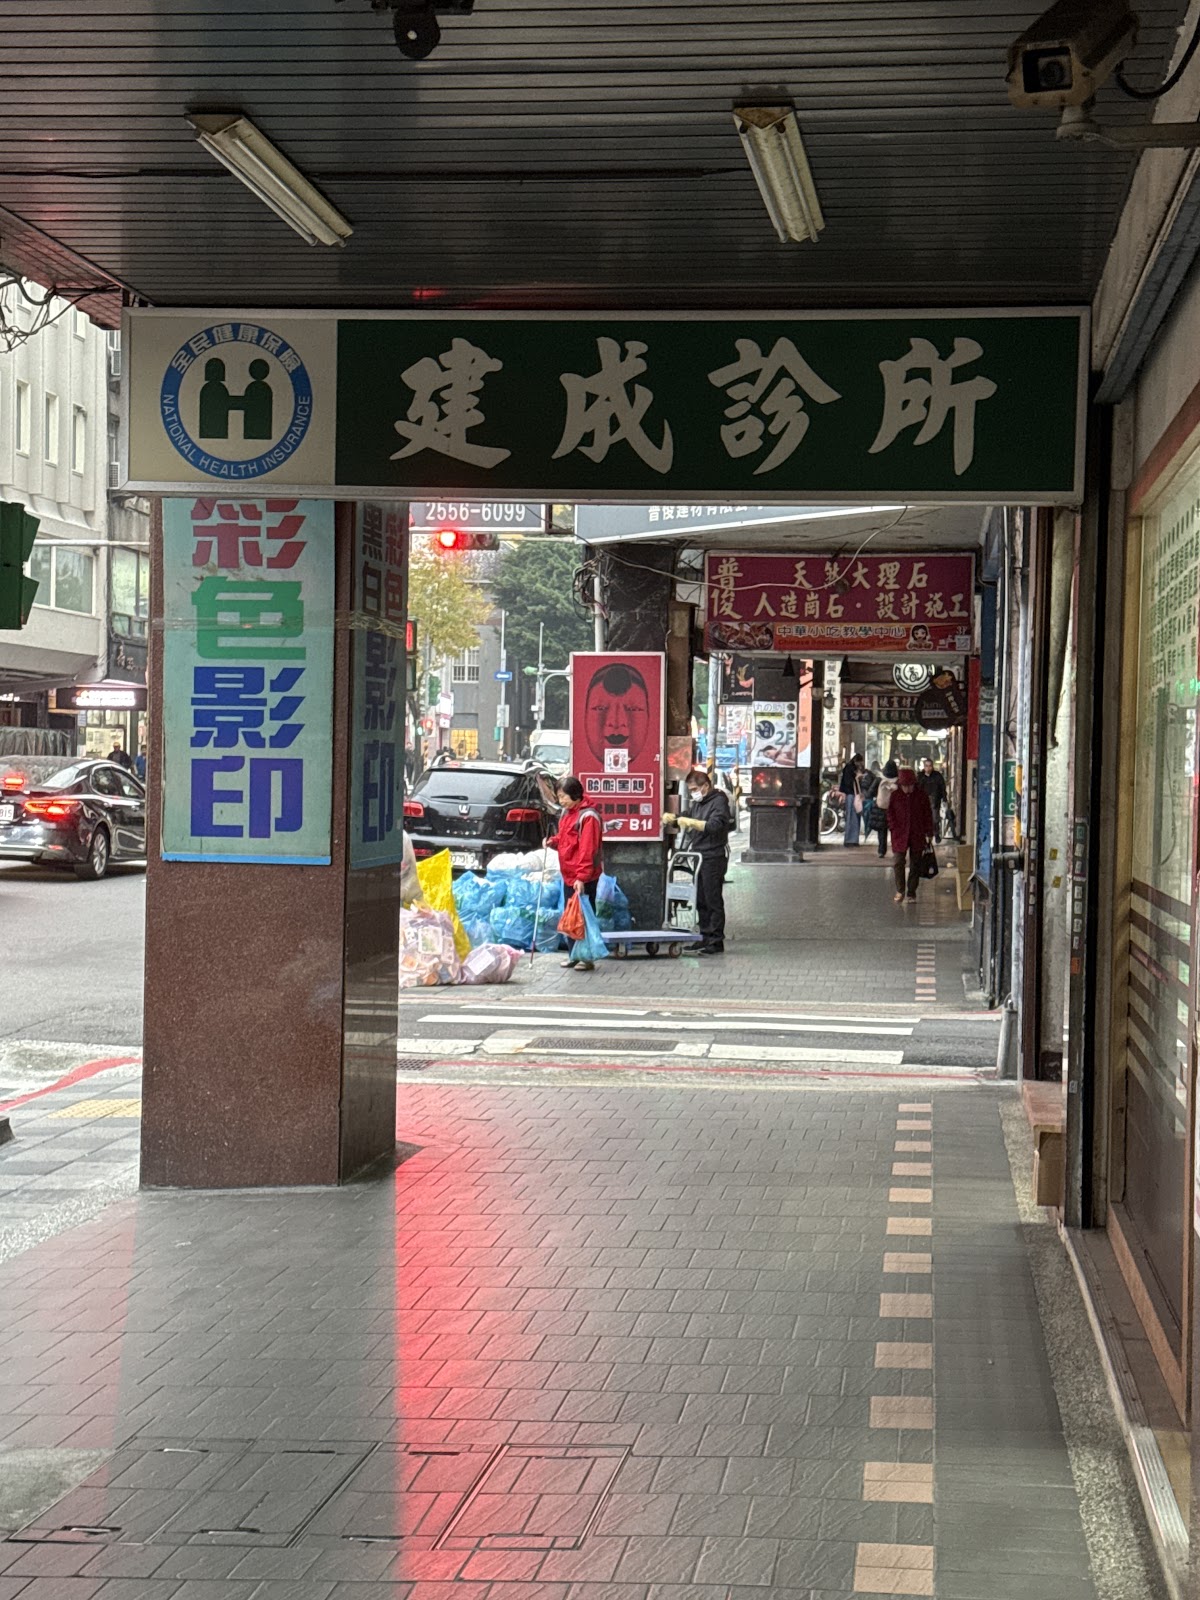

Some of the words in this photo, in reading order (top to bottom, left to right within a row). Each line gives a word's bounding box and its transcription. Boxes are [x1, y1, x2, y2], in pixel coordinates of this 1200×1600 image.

[173, 325, 302, 374] 全民健康保險
[389, 336, 998, 477] 建成診所
[163, 394, 197, 462] NATIONAL
[199, 456, 258, 477] HEALTH
[261, 396, 310, 470] INSURANCE
[425, 503, 526, 521] 2556-6099
[711, 557, 743, 620] 普俊
[793, 560, 929, 590] 天然大理石
[777, 624, 907, 638] 中華小吃教學中心
[190, 499, 307, 839] 彩色影印
